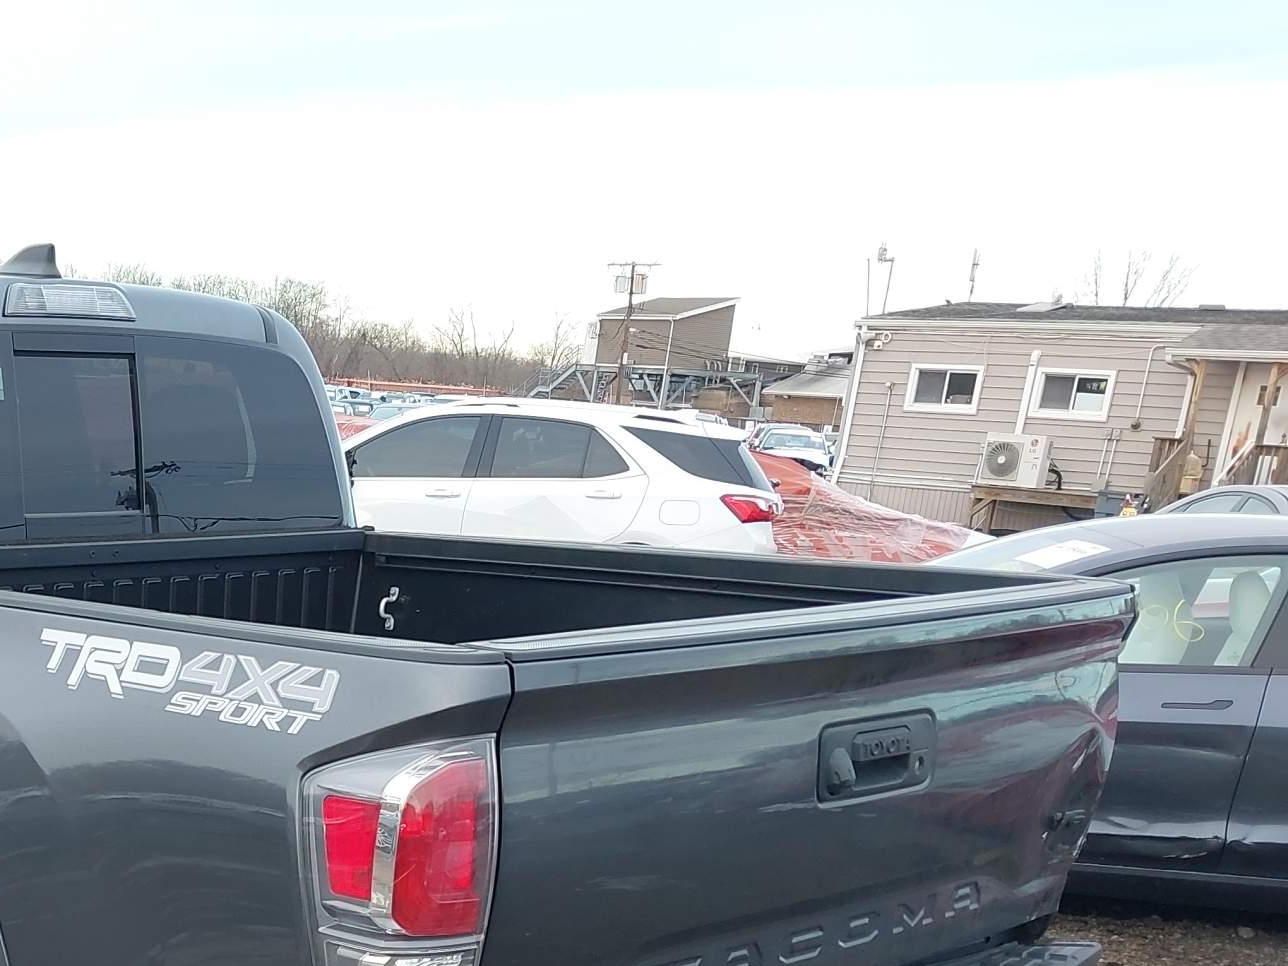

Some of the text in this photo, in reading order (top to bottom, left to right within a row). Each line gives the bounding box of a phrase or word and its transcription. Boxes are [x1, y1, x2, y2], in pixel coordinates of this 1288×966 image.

[40, 628, 182, 699] TRD
[164, 691, 323, 735] SPORT
[862, 735, 911, 756] TOYOTA
